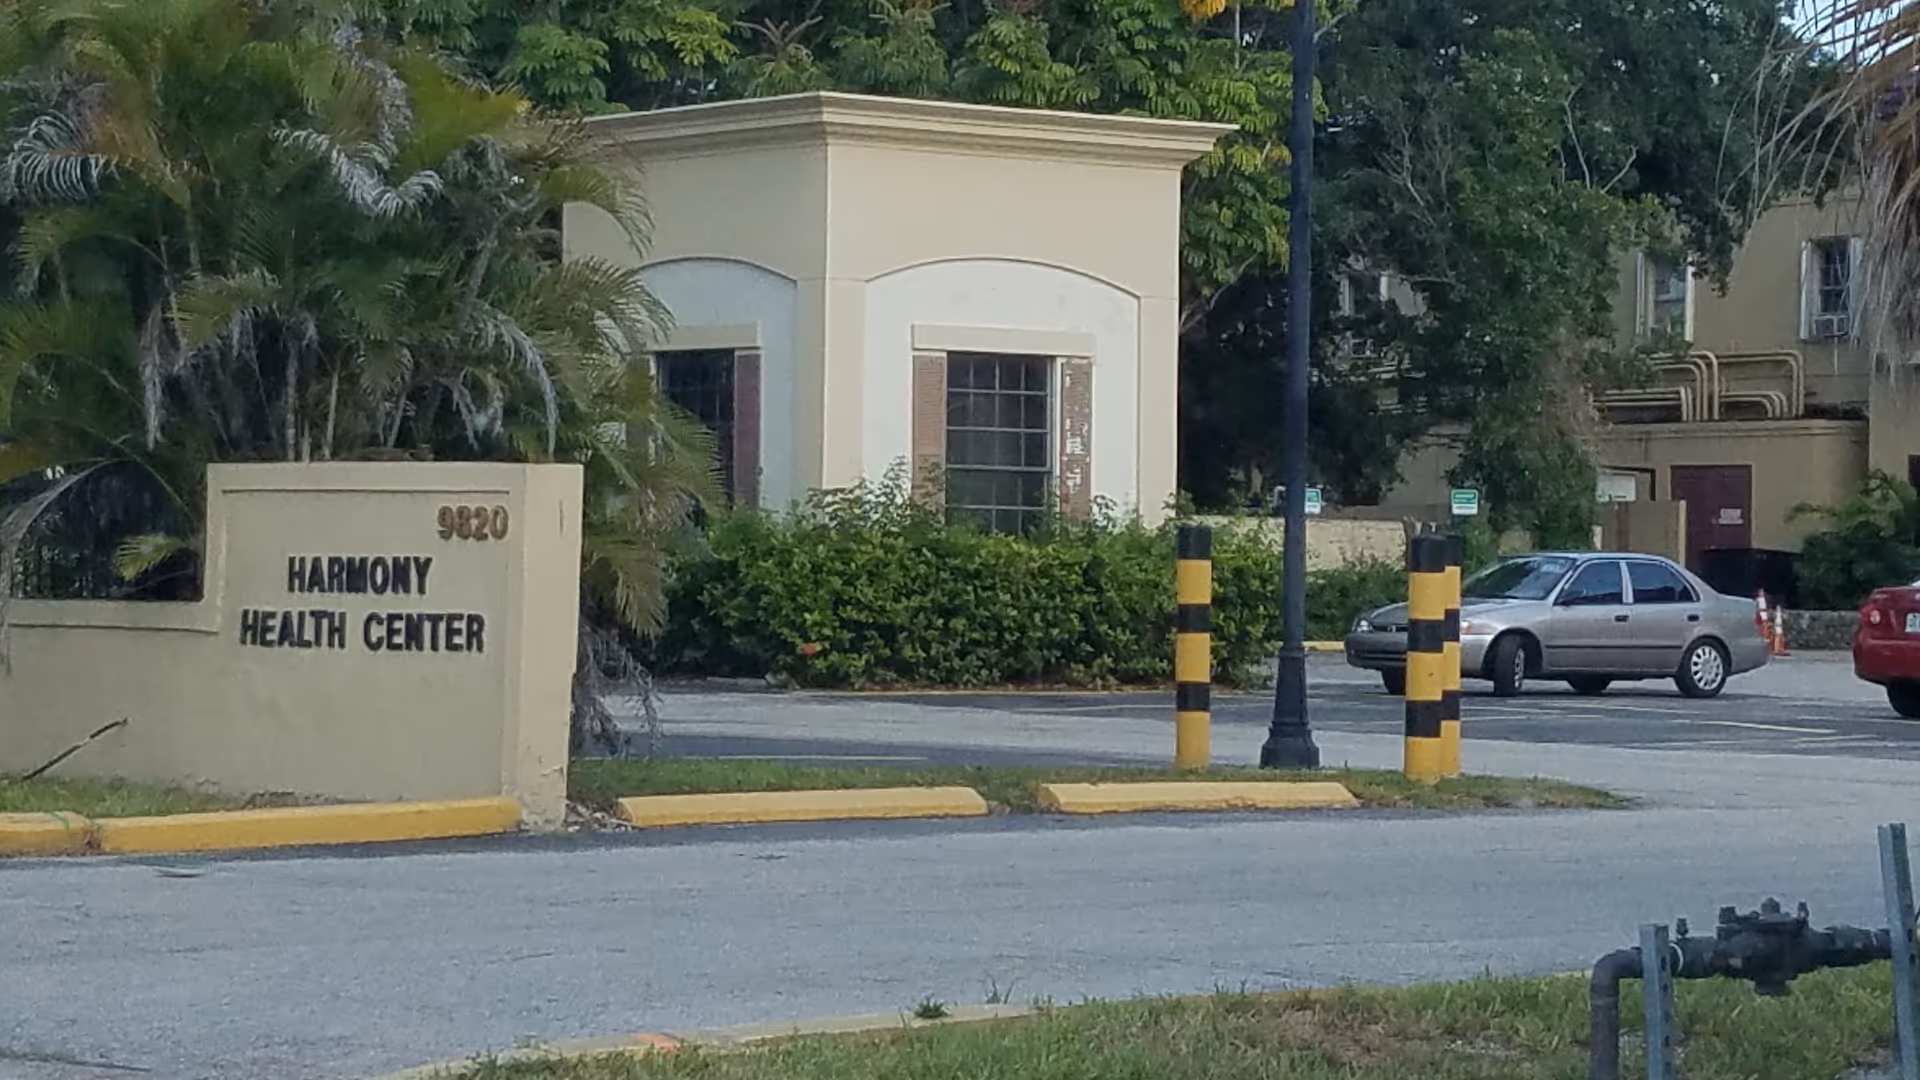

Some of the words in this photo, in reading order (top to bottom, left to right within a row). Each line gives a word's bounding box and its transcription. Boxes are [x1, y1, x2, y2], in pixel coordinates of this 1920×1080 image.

[437, 505, 509, 541] 9820
[288, 556, 433, 595] HARMONY
[240, 609, 346, 649] HEALTH
[363, 612, 485, 653] CENTER
